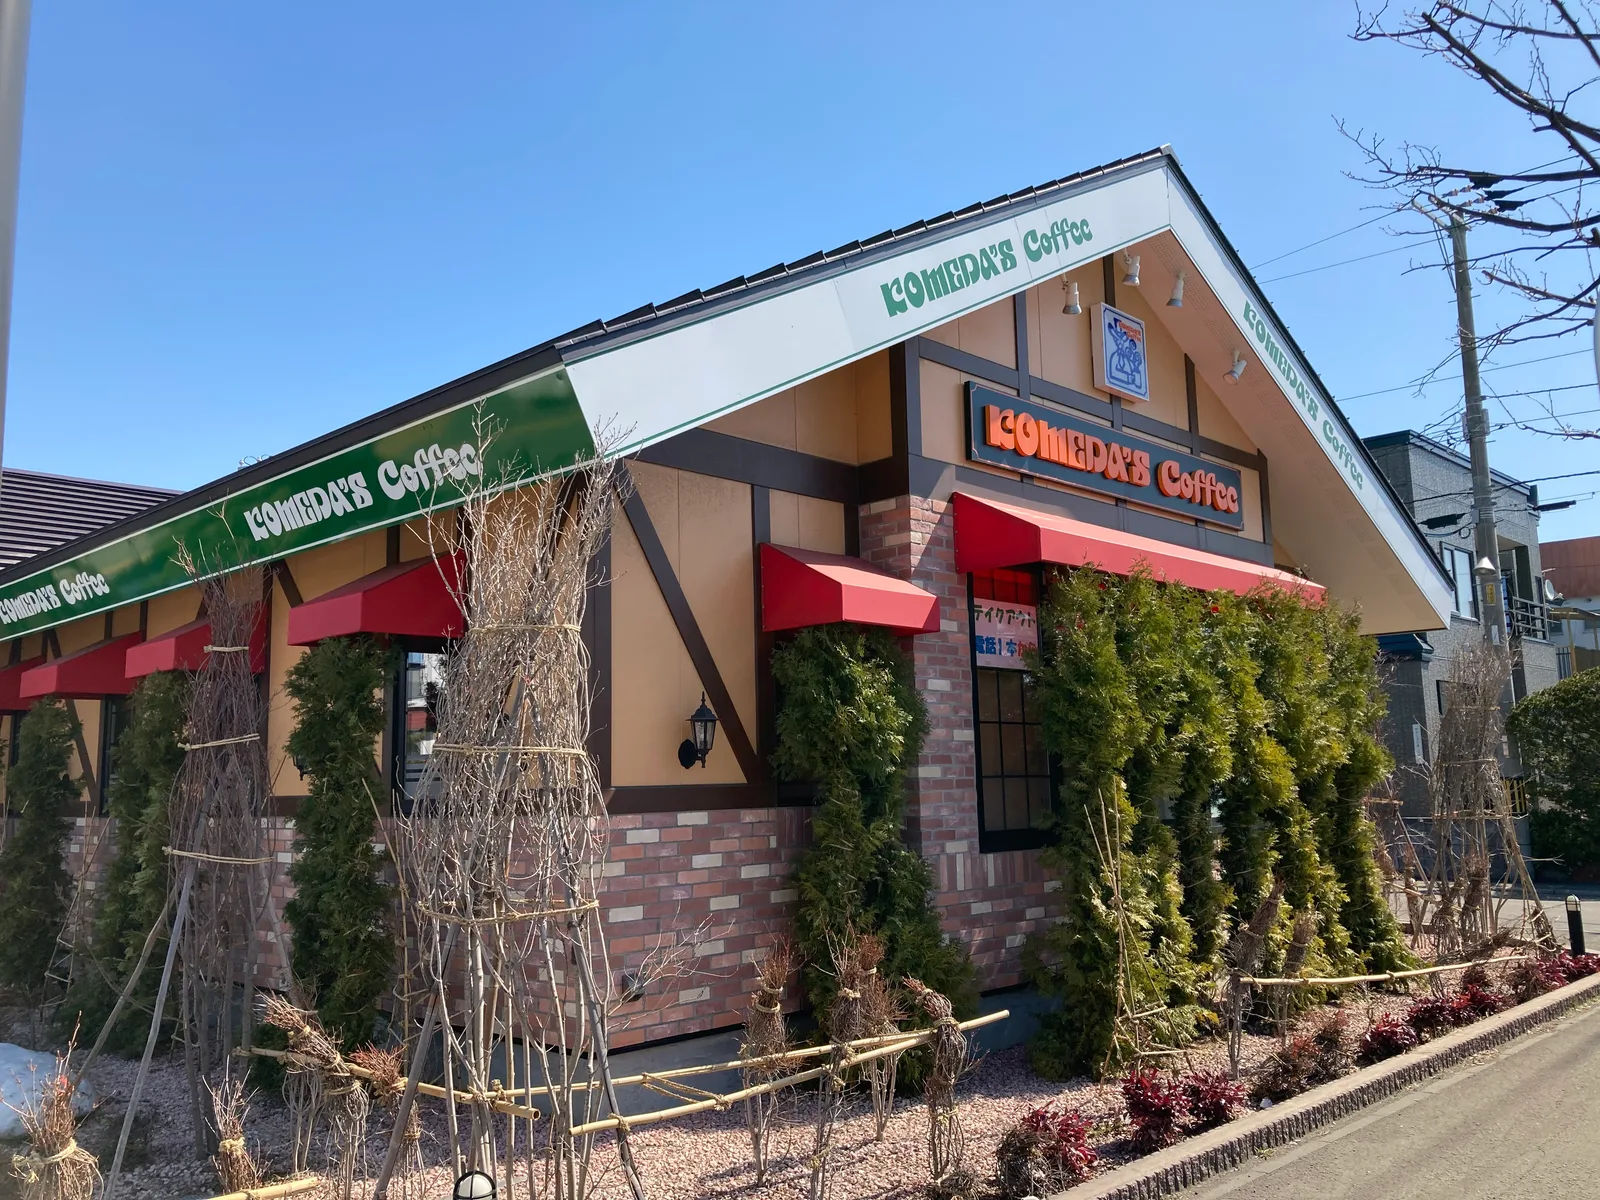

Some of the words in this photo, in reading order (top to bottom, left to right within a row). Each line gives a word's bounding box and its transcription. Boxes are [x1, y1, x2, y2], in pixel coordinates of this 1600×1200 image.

[880, 238, 1018, 317] KOMEDA'S
[1022, 217, 1094, 263] Coffee
[1243, 300, 1319, 422] KOMEDA'S
[1322, 419, 1364, 491] Coffee
[243, 471, 373, 541] KOMEDA'S
[377, 441, 480, 500] Coffee
[984, 404, 1151, 488] KOMEDA'S
[1157, 460, 1241, 514] Coffee
[59, 571, 110, 605] Coffee
